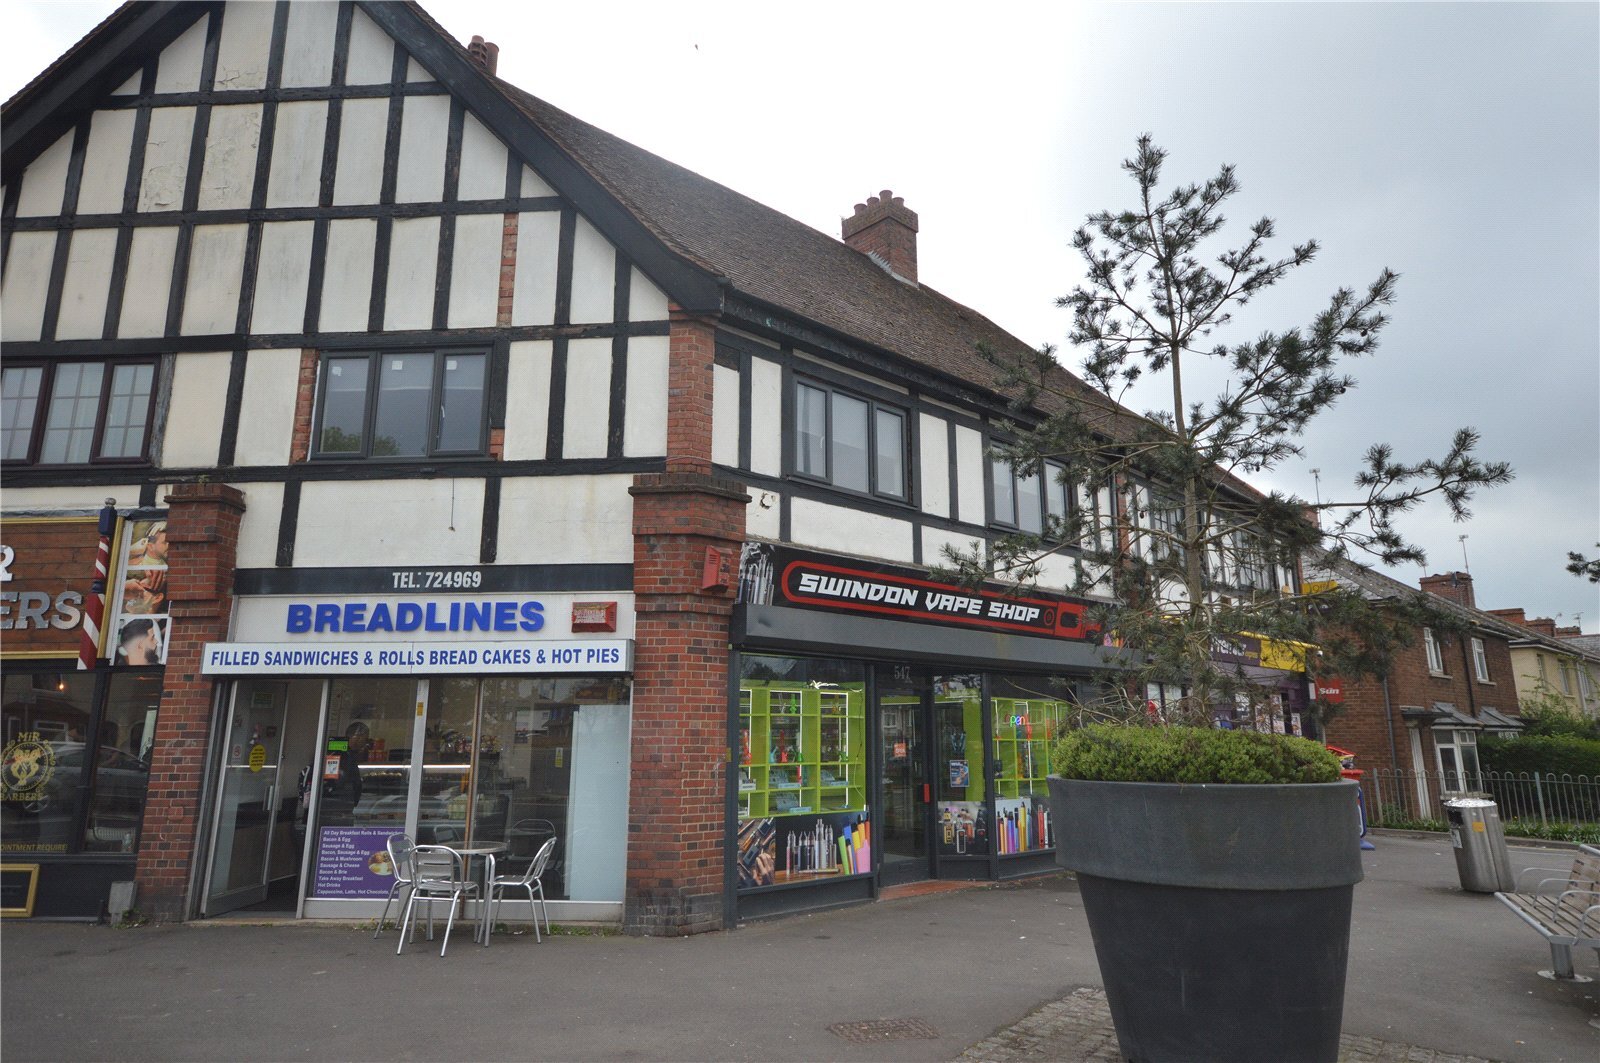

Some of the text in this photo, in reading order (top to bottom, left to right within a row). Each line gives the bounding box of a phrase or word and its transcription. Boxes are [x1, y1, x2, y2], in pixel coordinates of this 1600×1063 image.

[425, 571, 482, 588] 724969
[798, 573, 1040, 622] SWINDON VAPE SHOP
[286, 601, 545, 633] BREADLINES
[211, 648, 620, 666] FILLED SANDWICHES & ROLLS BREAD CAKES & HOT PIES
[894, 665, 910, 680] 547
